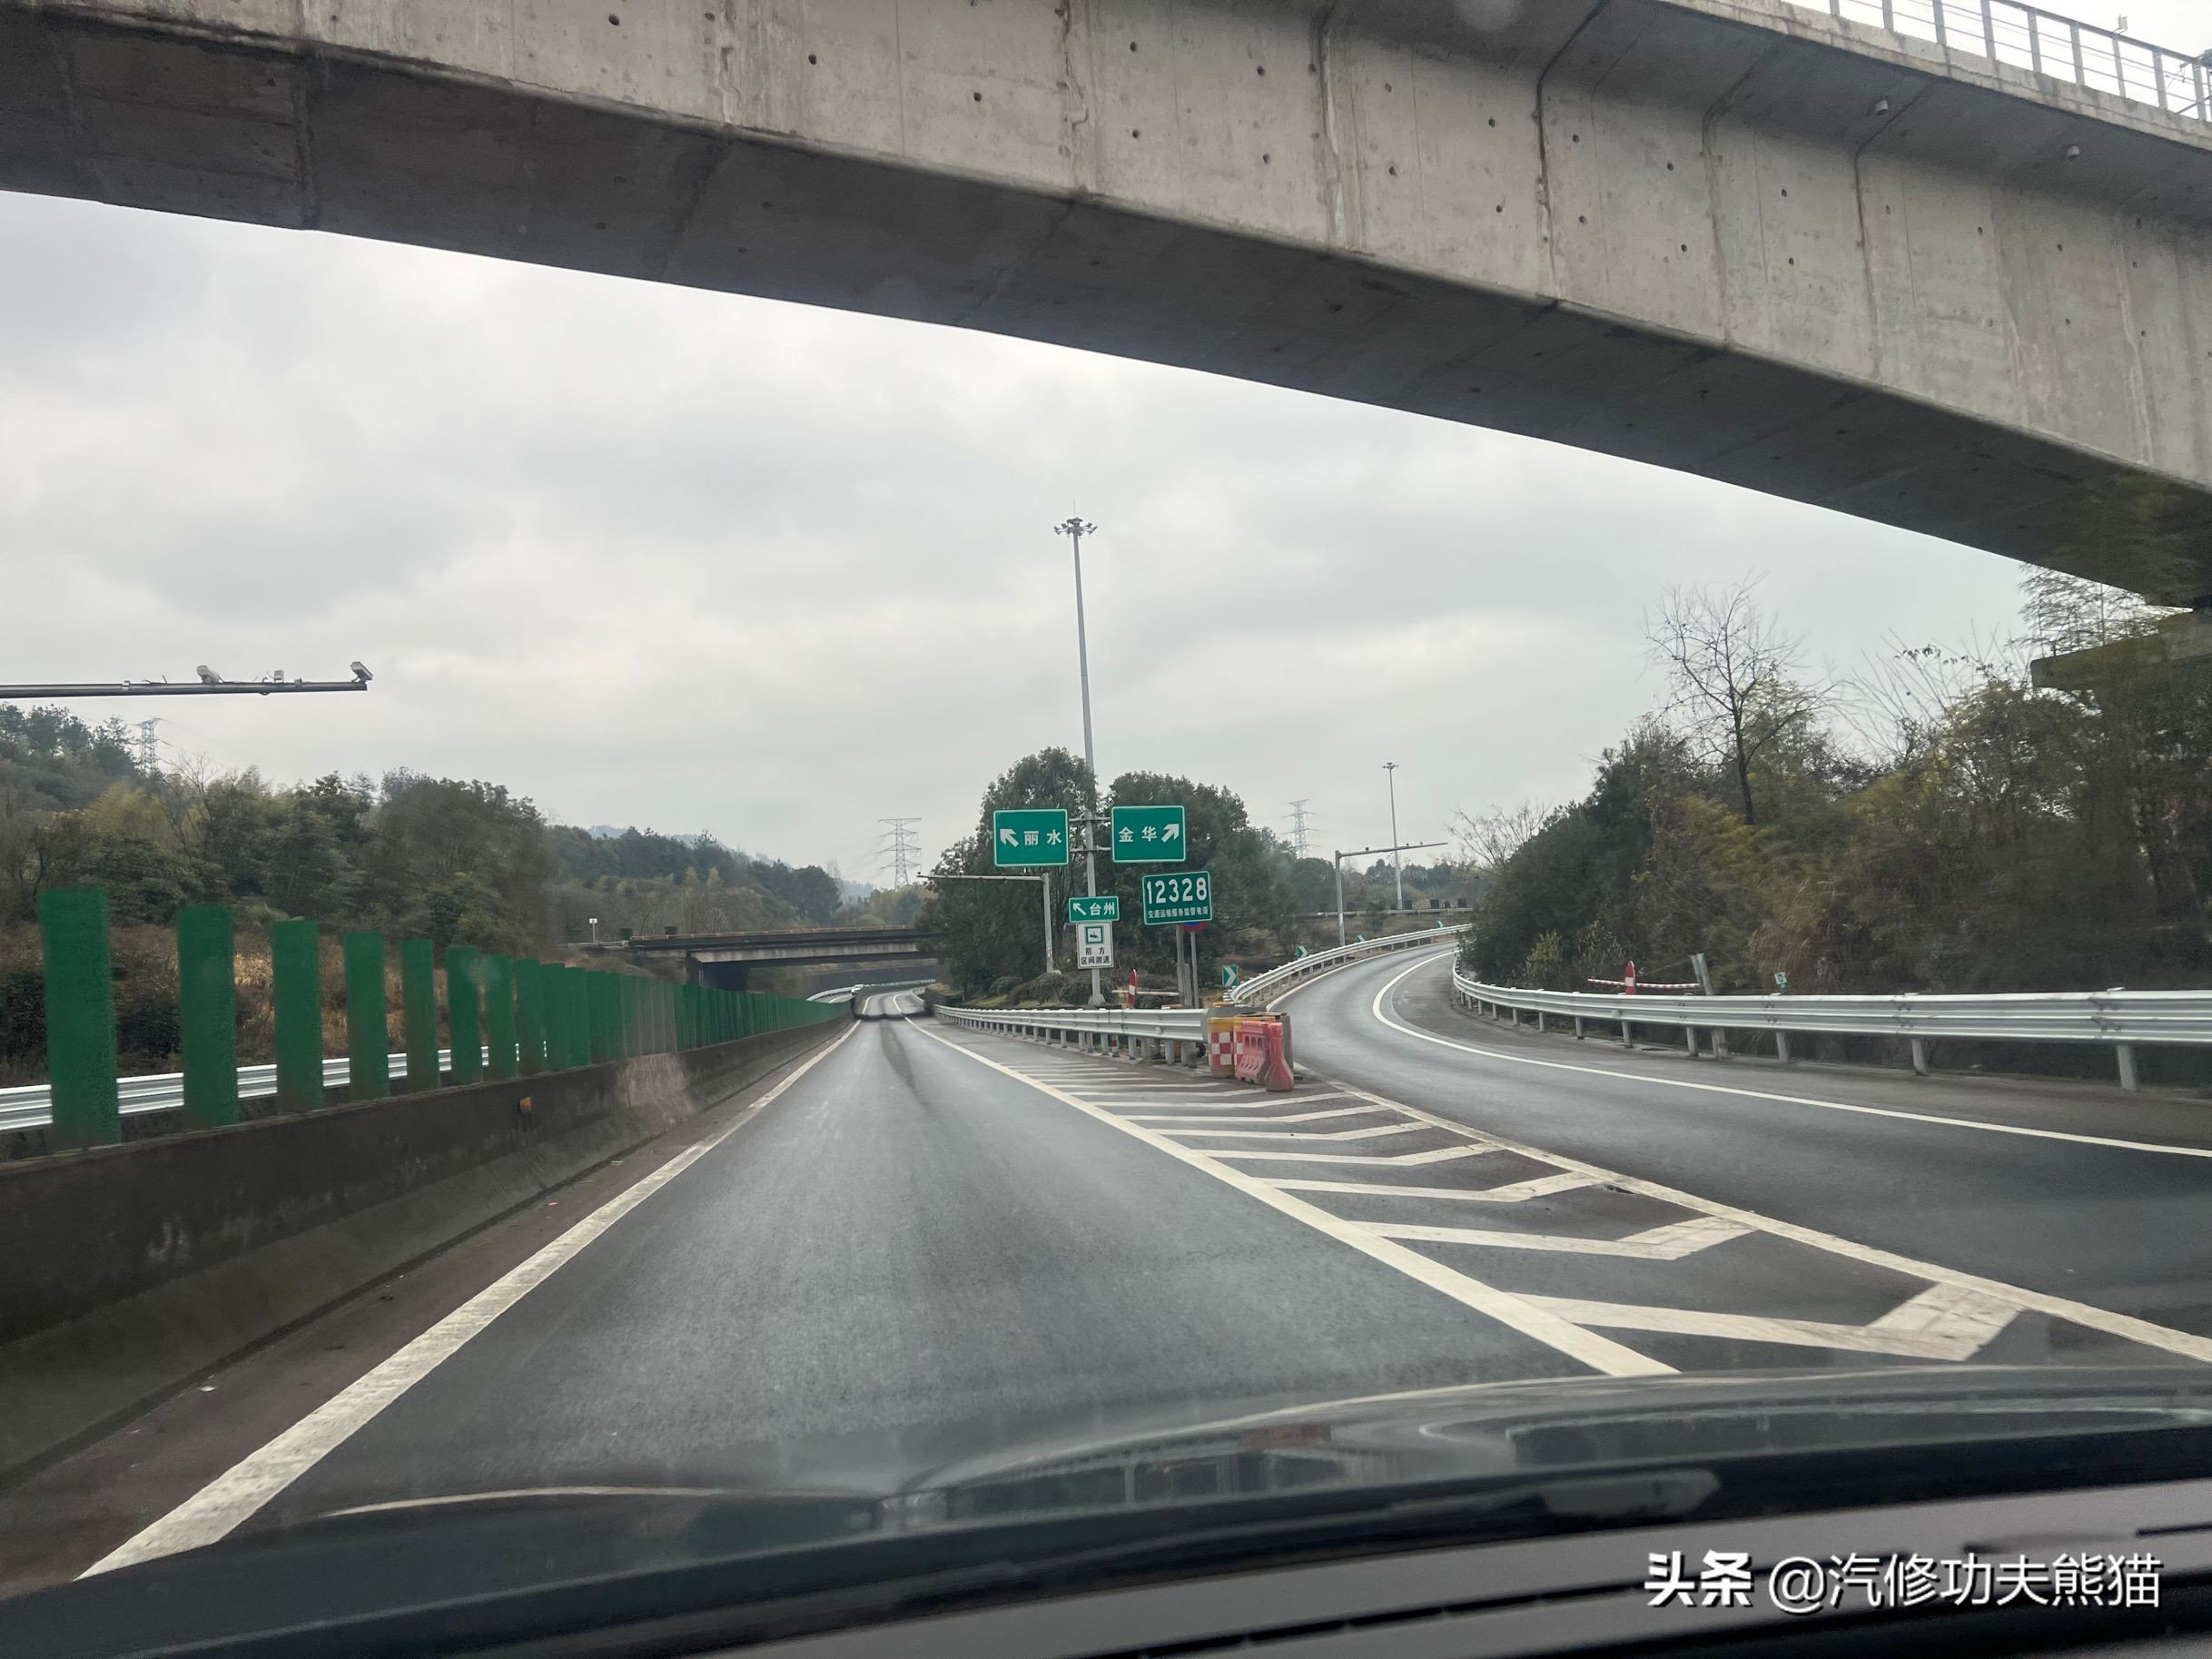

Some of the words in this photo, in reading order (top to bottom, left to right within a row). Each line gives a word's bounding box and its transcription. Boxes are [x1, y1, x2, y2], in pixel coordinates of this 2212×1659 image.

[1023, 829, 1062, 846] 丽水
[1118, 825, 1157, 843] 金华
[1146, 876, 1208, 904] 12328
[1090, 902, 1115, 916] 台州
[1085, 946, 1105, 955] 前方
[1081, 955, 1110, 965] 区间测速
